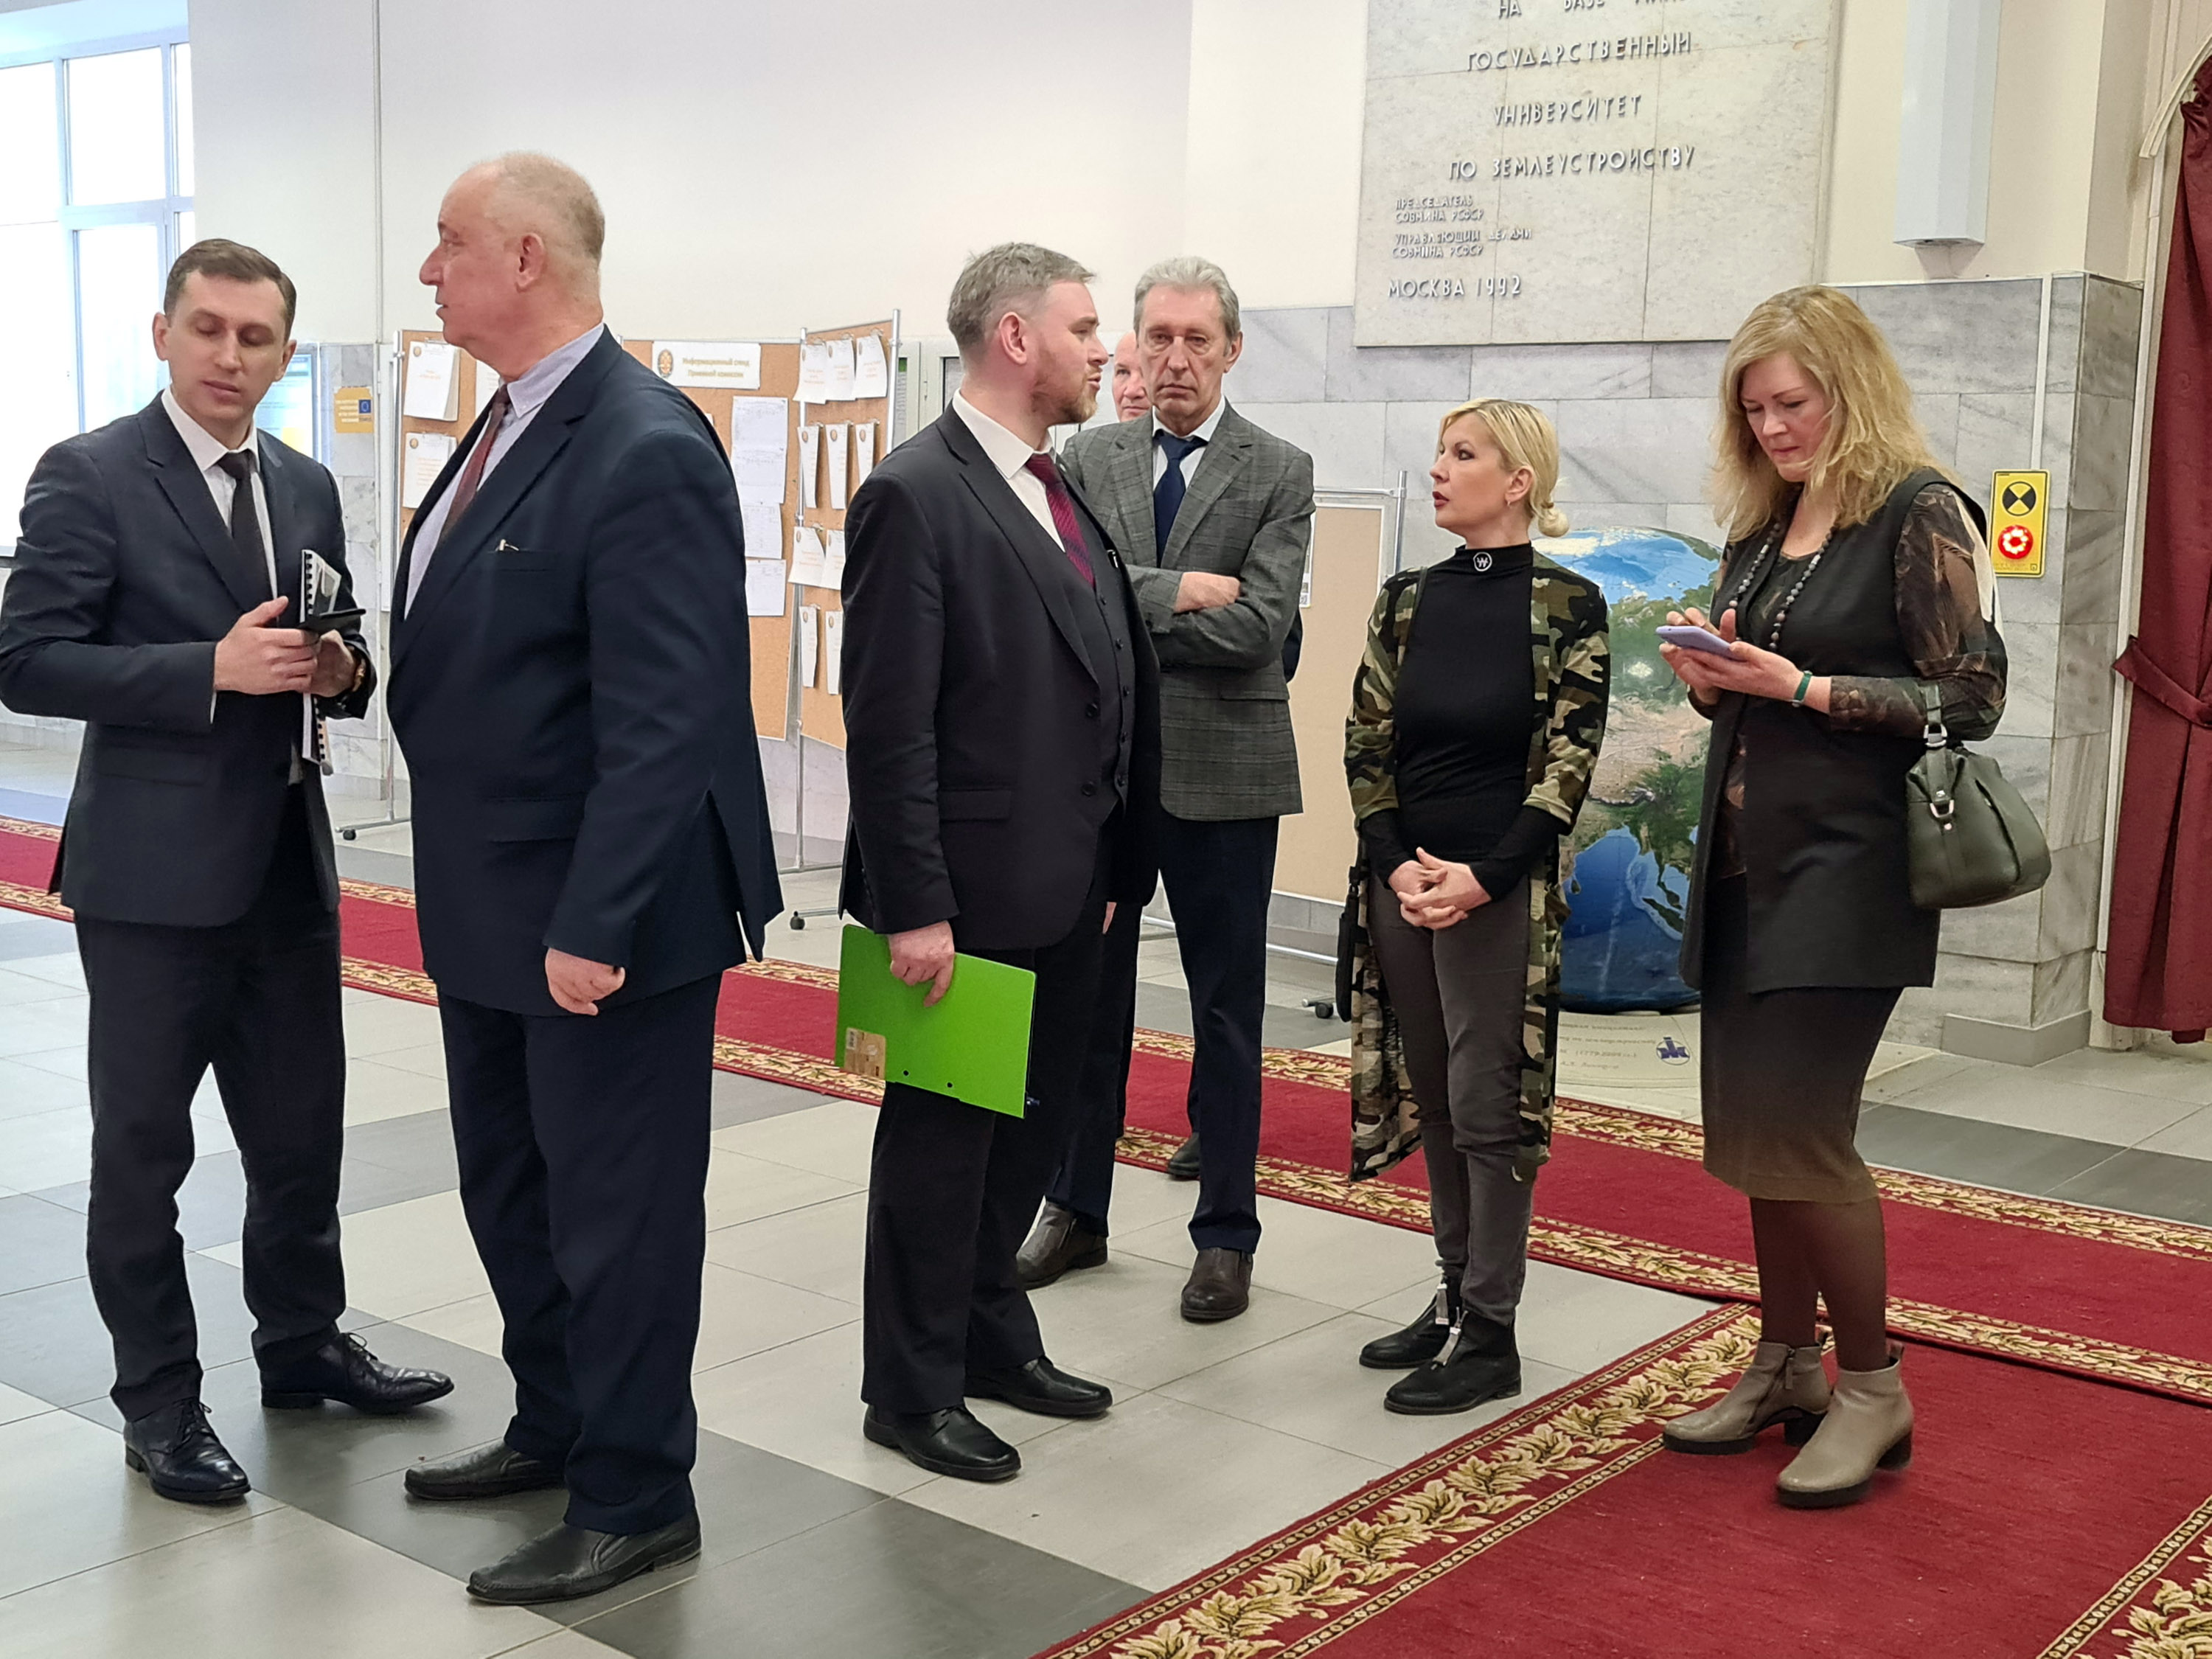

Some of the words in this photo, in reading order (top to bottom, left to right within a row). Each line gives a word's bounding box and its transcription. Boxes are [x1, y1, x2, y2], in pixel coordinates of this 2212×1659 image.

[1498, 0, 1522, 19] НА
[1494, 94, 1642, 127] УНИВЕРСИТЕТ
[1450, 160, 1477, 180] ПО
[1388, 278, 1464, 297] МОСКВА
[1477, 274, 1521, 296] 1992
